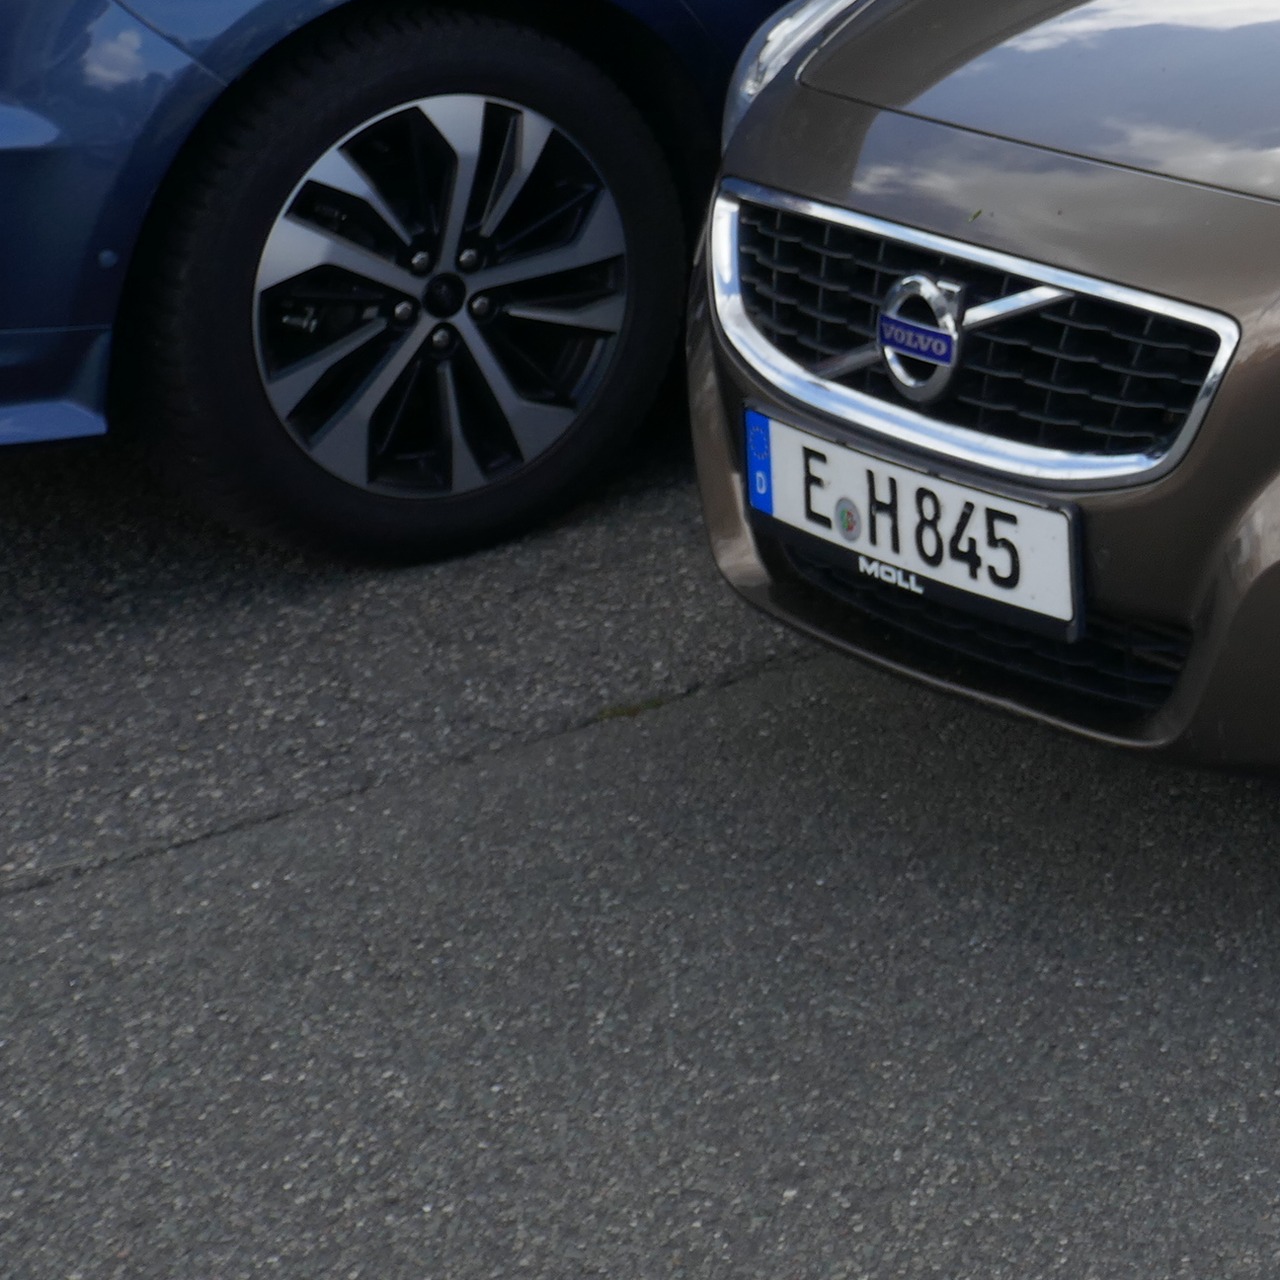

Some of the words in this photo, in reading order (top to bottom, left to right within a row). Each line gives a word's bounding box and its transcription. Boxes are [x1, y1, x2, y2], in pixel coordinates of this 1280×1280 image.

[880, 324, 948, 357] VOLVO
[755, 470, 767, 496] D
[802, 445, 832, 530] E
[866, 469, 899, 556] H
[914, 487, 1021, 590] 845
[857, 555, 925, 595] MOLL
